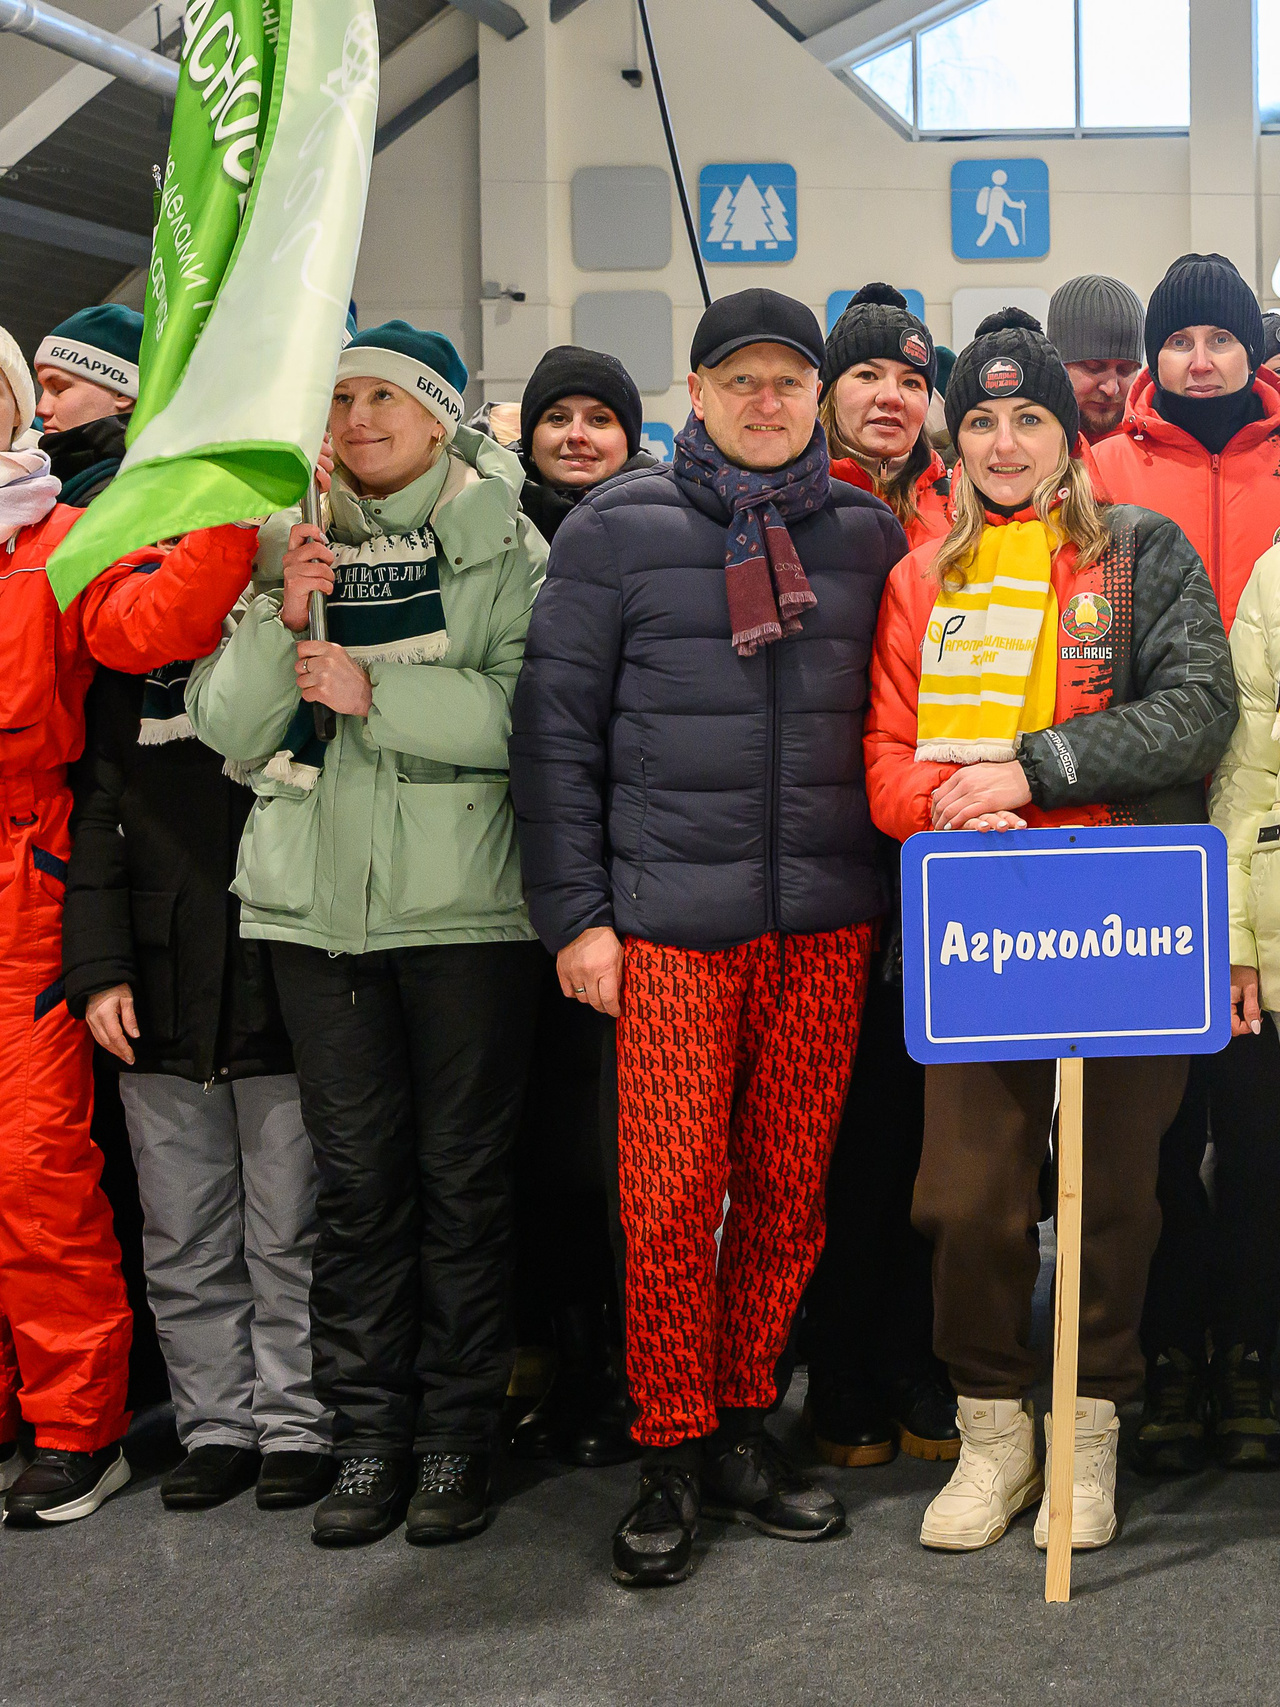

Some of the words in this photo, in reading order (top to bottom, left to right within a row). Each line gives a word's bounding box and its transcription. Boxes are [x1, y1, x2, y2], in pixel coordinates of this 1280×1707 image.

[50, 346, 129, 385] БЕЛАРУСЬ
[340, 582, 392, 599] ЛЕСА
[1061, 647, 1113, 660] BELARUS
[940, 913, 1194, 975] Агрохолдинг
